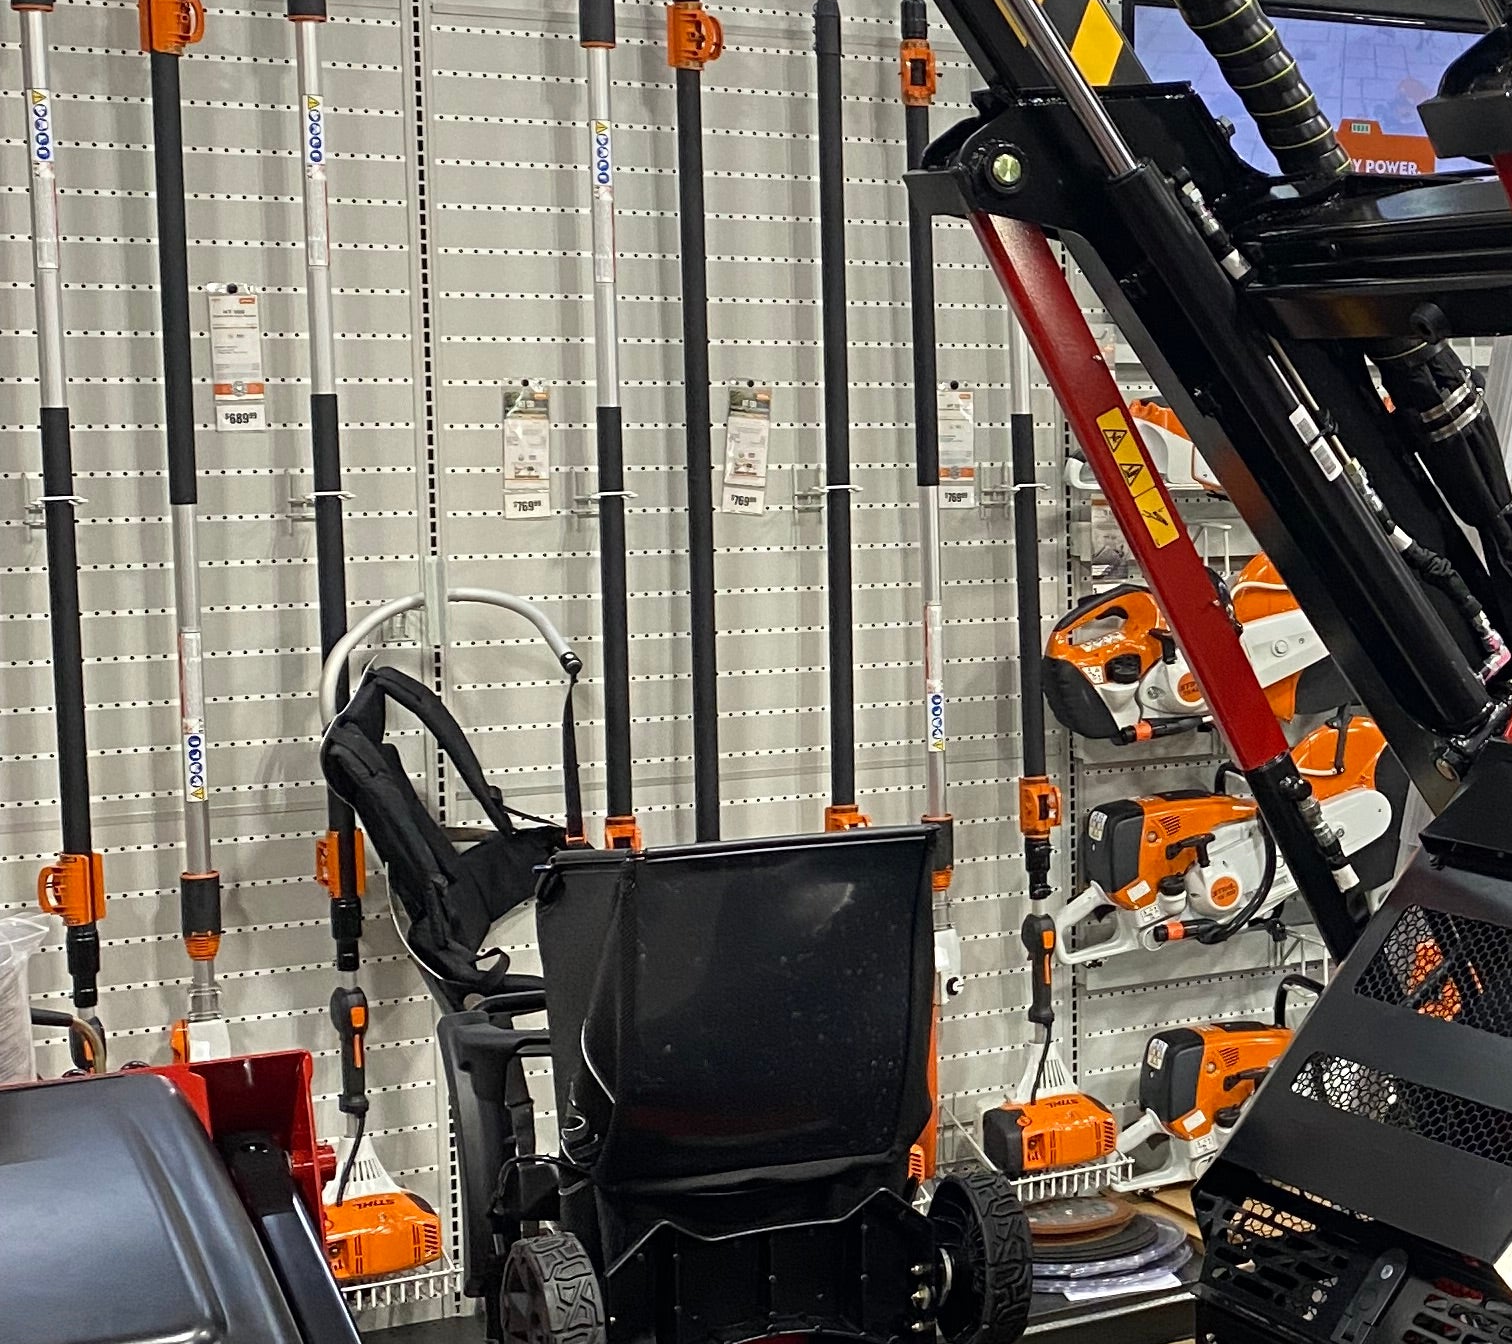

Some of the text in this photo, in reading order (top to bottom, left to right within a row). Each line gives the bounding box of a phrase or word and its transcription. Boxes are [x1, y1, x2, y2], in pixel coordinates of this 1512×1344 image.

[1365, 160, 1421, 174] POWER.
[1044, 1099, 1079, 1108] STIHL
[352, 1198, 396, 1210] STIHL
